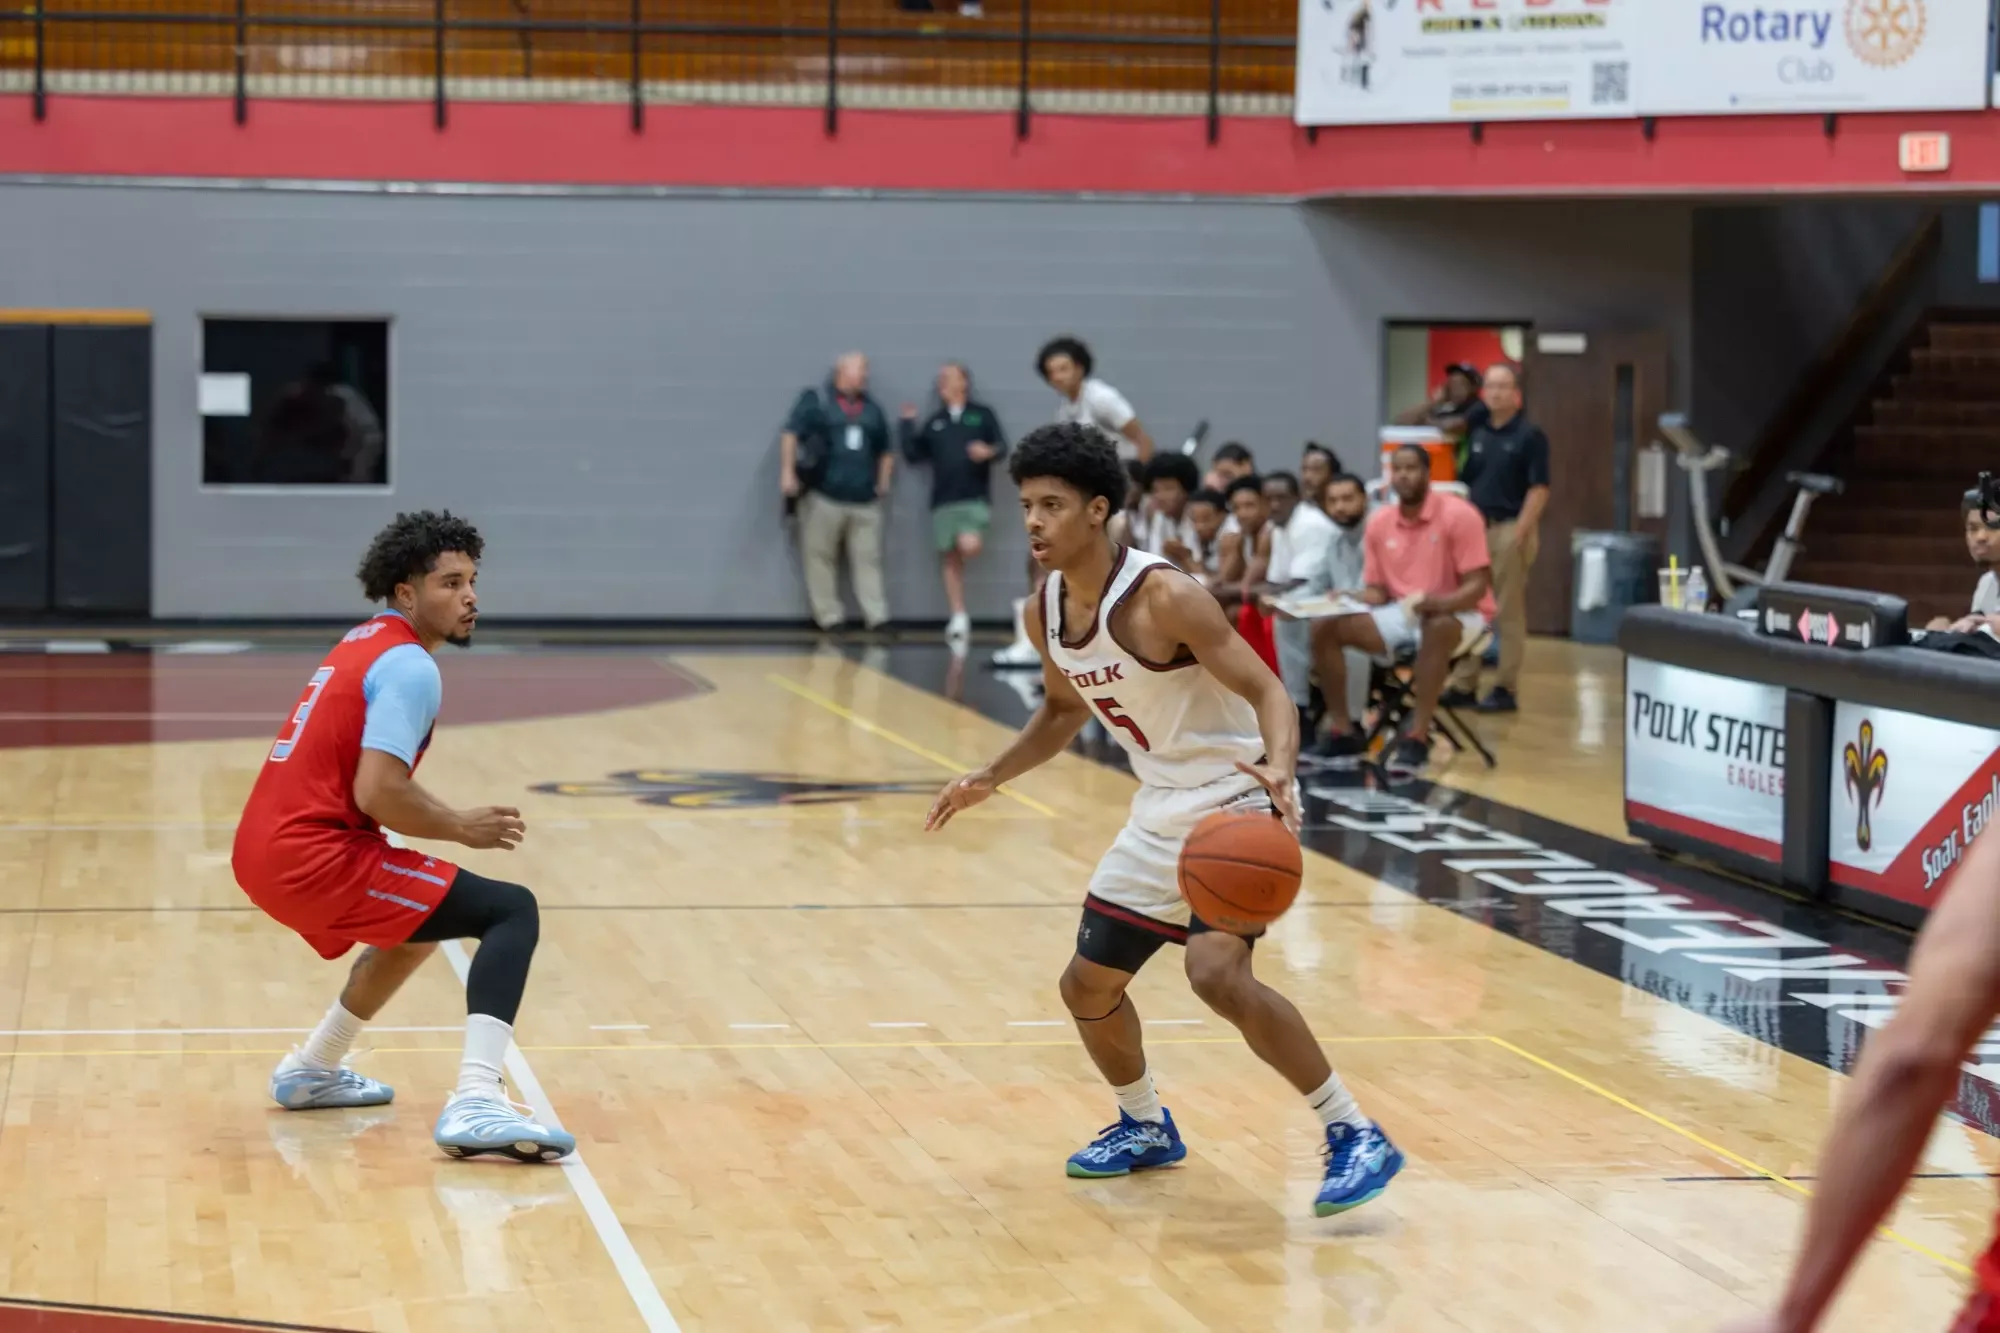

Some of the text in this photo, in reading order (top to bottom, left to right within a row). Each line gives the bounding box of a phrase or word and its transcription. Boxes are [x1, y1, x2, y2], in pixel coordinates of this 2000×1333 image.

[1700, 4, 1832, 50] Rotary
[1776, 54, 1835, 85] Club
[269, 666, 336, 762] 3
[1092, 697, 1150, 752] 5
[1633, 691, 1786, 769] POLK STATE
[1727, 763, 1786, 798] EAGLES
[1921, 828, 1963, 890] Soar,
